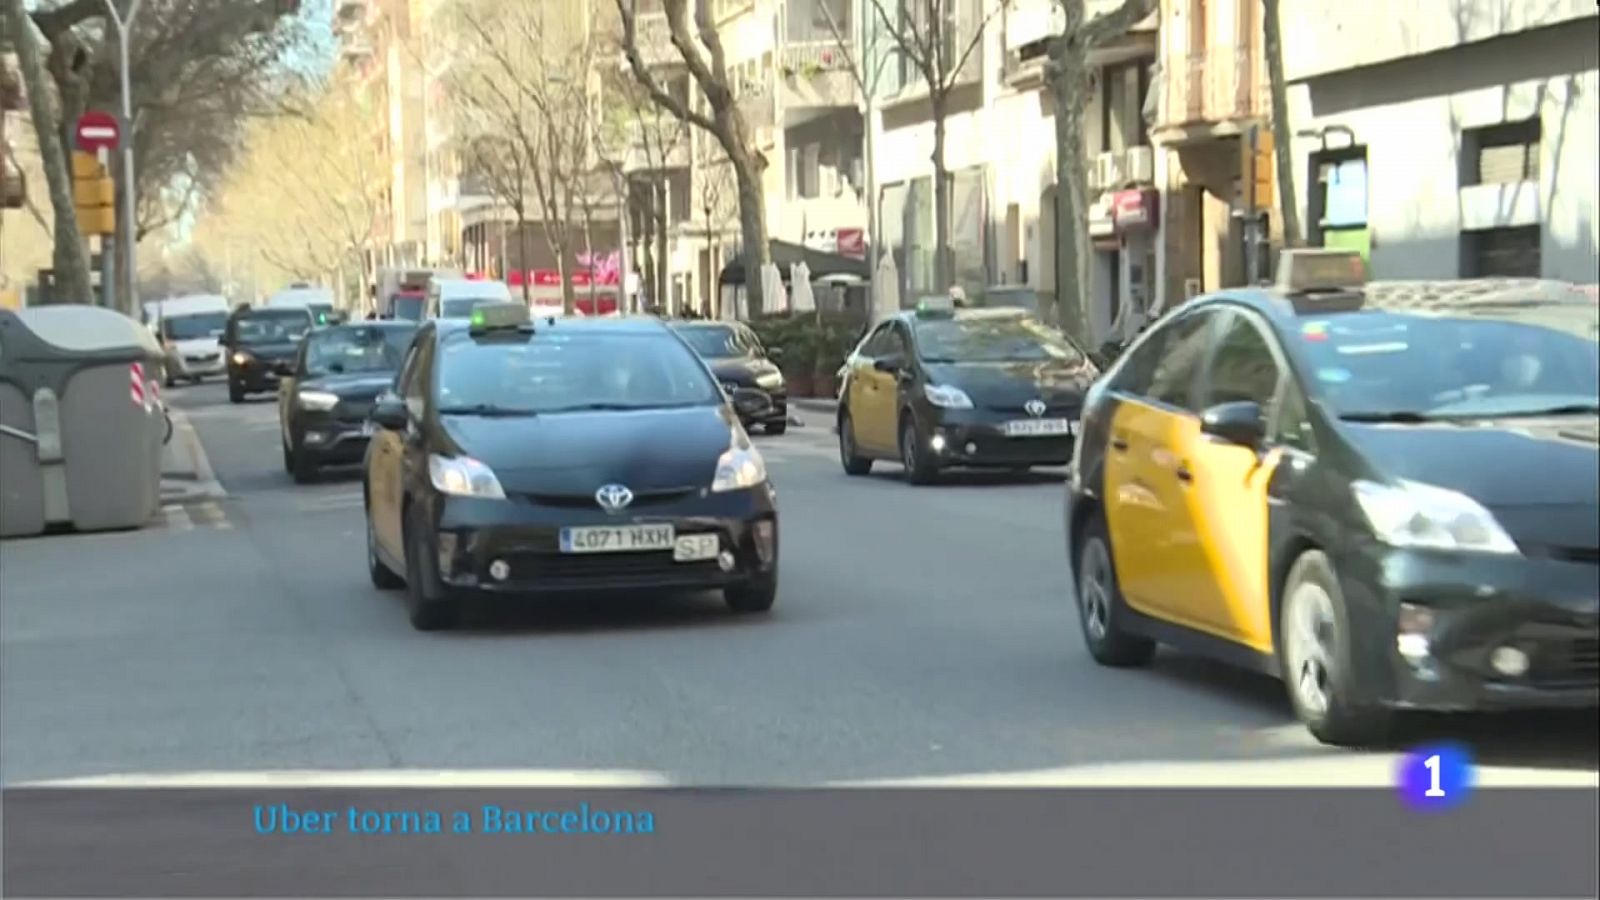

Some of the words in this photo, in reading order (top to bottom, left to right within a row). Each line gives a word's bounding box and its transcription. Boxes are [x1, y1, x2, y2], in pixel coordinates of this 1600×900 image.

[573, 529, 623, 548] 4071
[631, 526, 671, 546] HXH
[679, 538, 714, 557] SP
